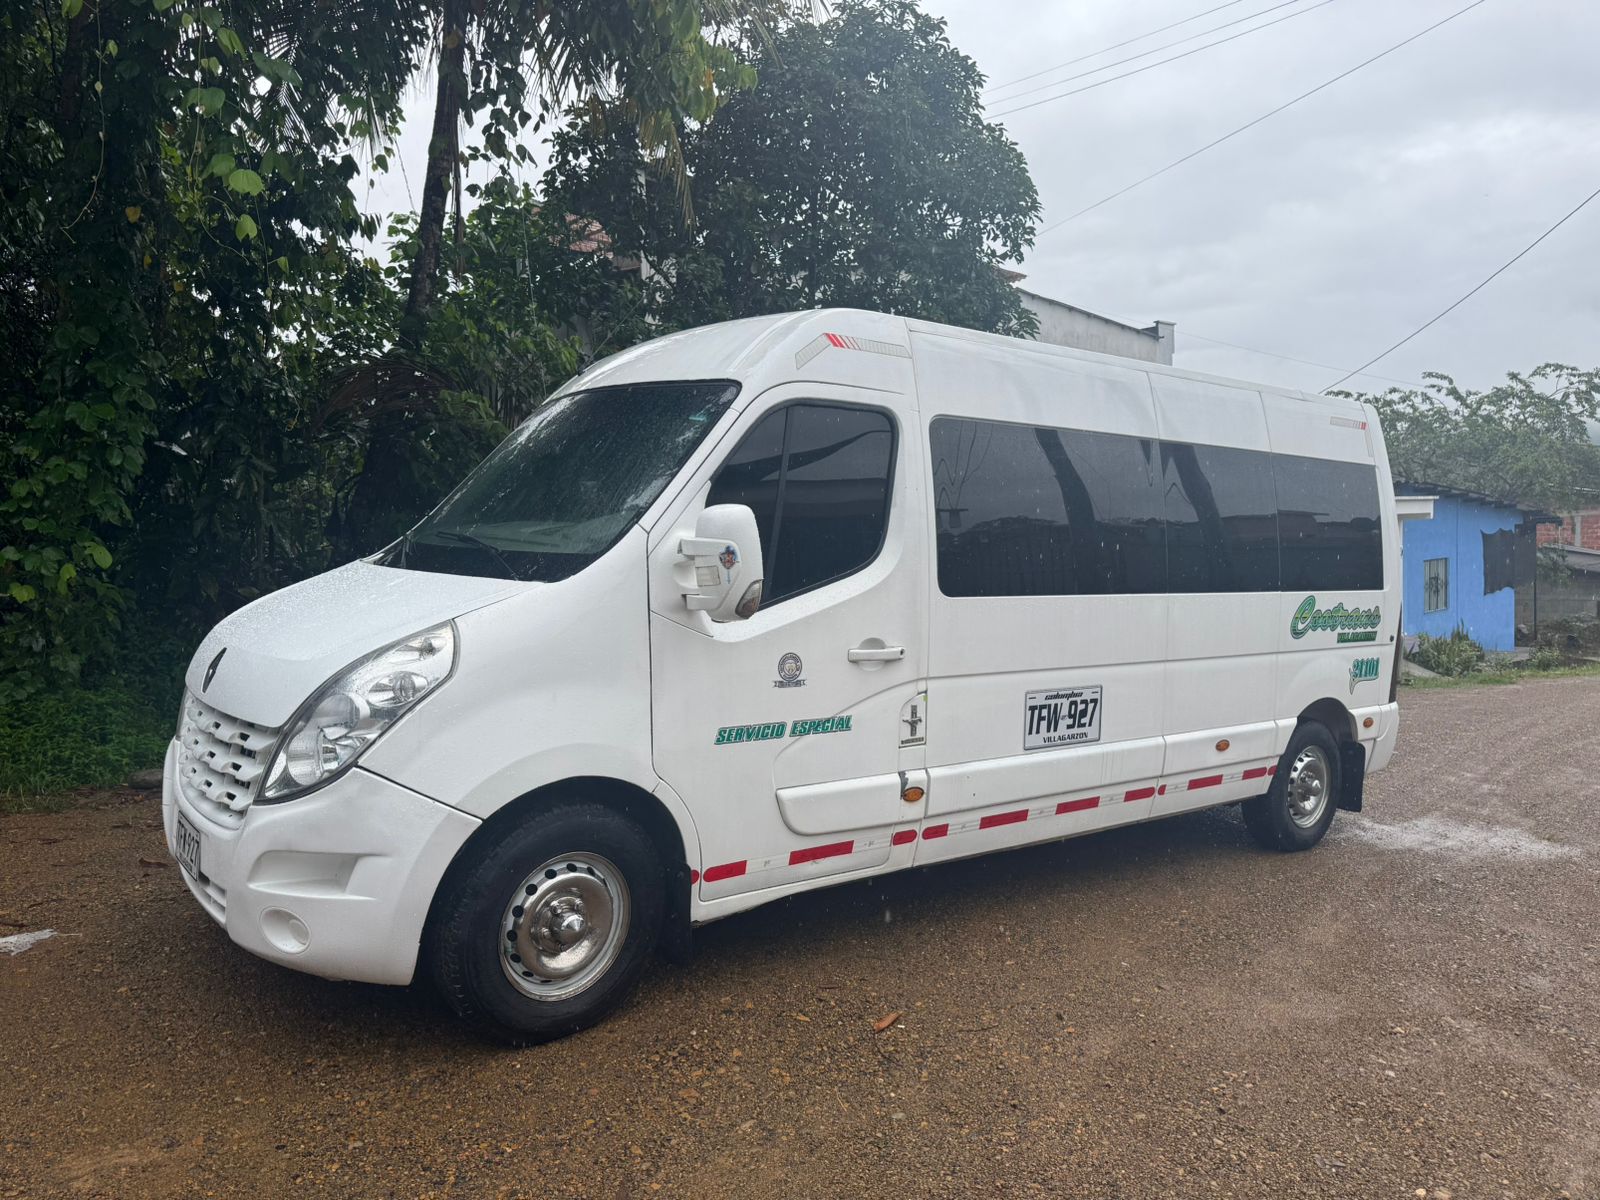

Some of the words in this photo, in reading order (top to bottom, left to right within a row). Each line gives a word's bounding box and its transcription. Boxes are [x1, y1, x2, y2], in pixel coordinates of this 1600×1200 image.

[1291, 595, 1381, 639] Cootrans
[714, 721, 787, 745] SERVICIO
[789, 715, 852, 737] ESPECIAL
[1043, 732, 1088, 743] VILLAGARZON
